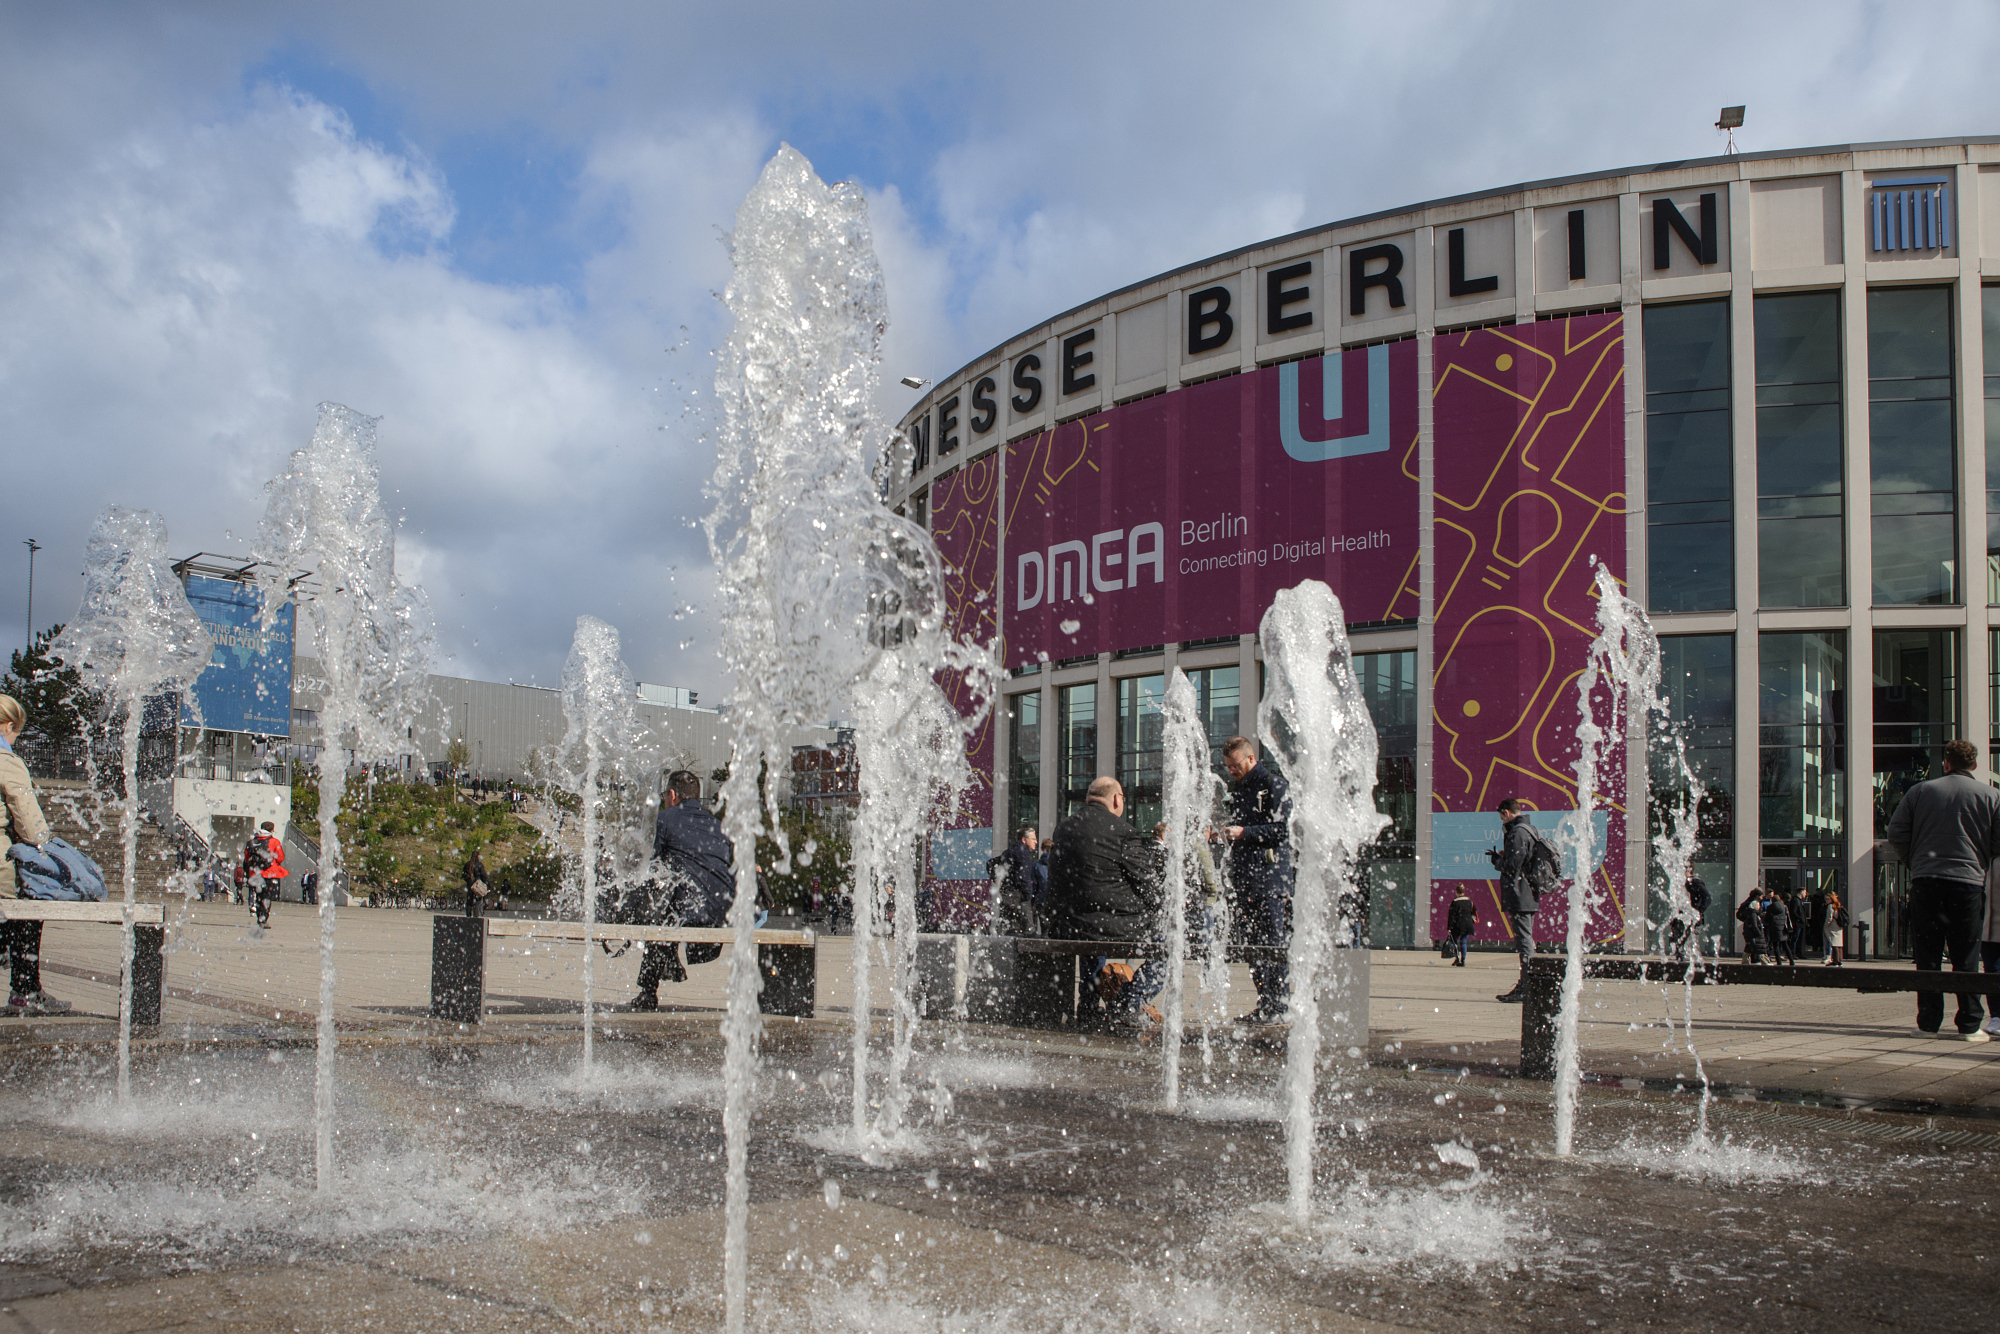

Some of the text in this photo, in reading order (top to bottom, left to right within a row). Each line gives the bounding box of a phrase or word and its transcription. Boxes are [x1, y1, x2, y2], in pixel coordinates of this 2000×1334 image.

[911, 193, 1718, 476] MESSE BERLIN
[1181, 512, 1248, 546] Berlin
[1017, 521, 1164, 612] DMEA
[1179, 529, 1391, 575] Connecting Digital Health
[202, 621, 231, 635] STING
[233, 626, 251, 638] THE
[211, 632, 236, 647] AND
[270, 716, 286, 724] Berlin
